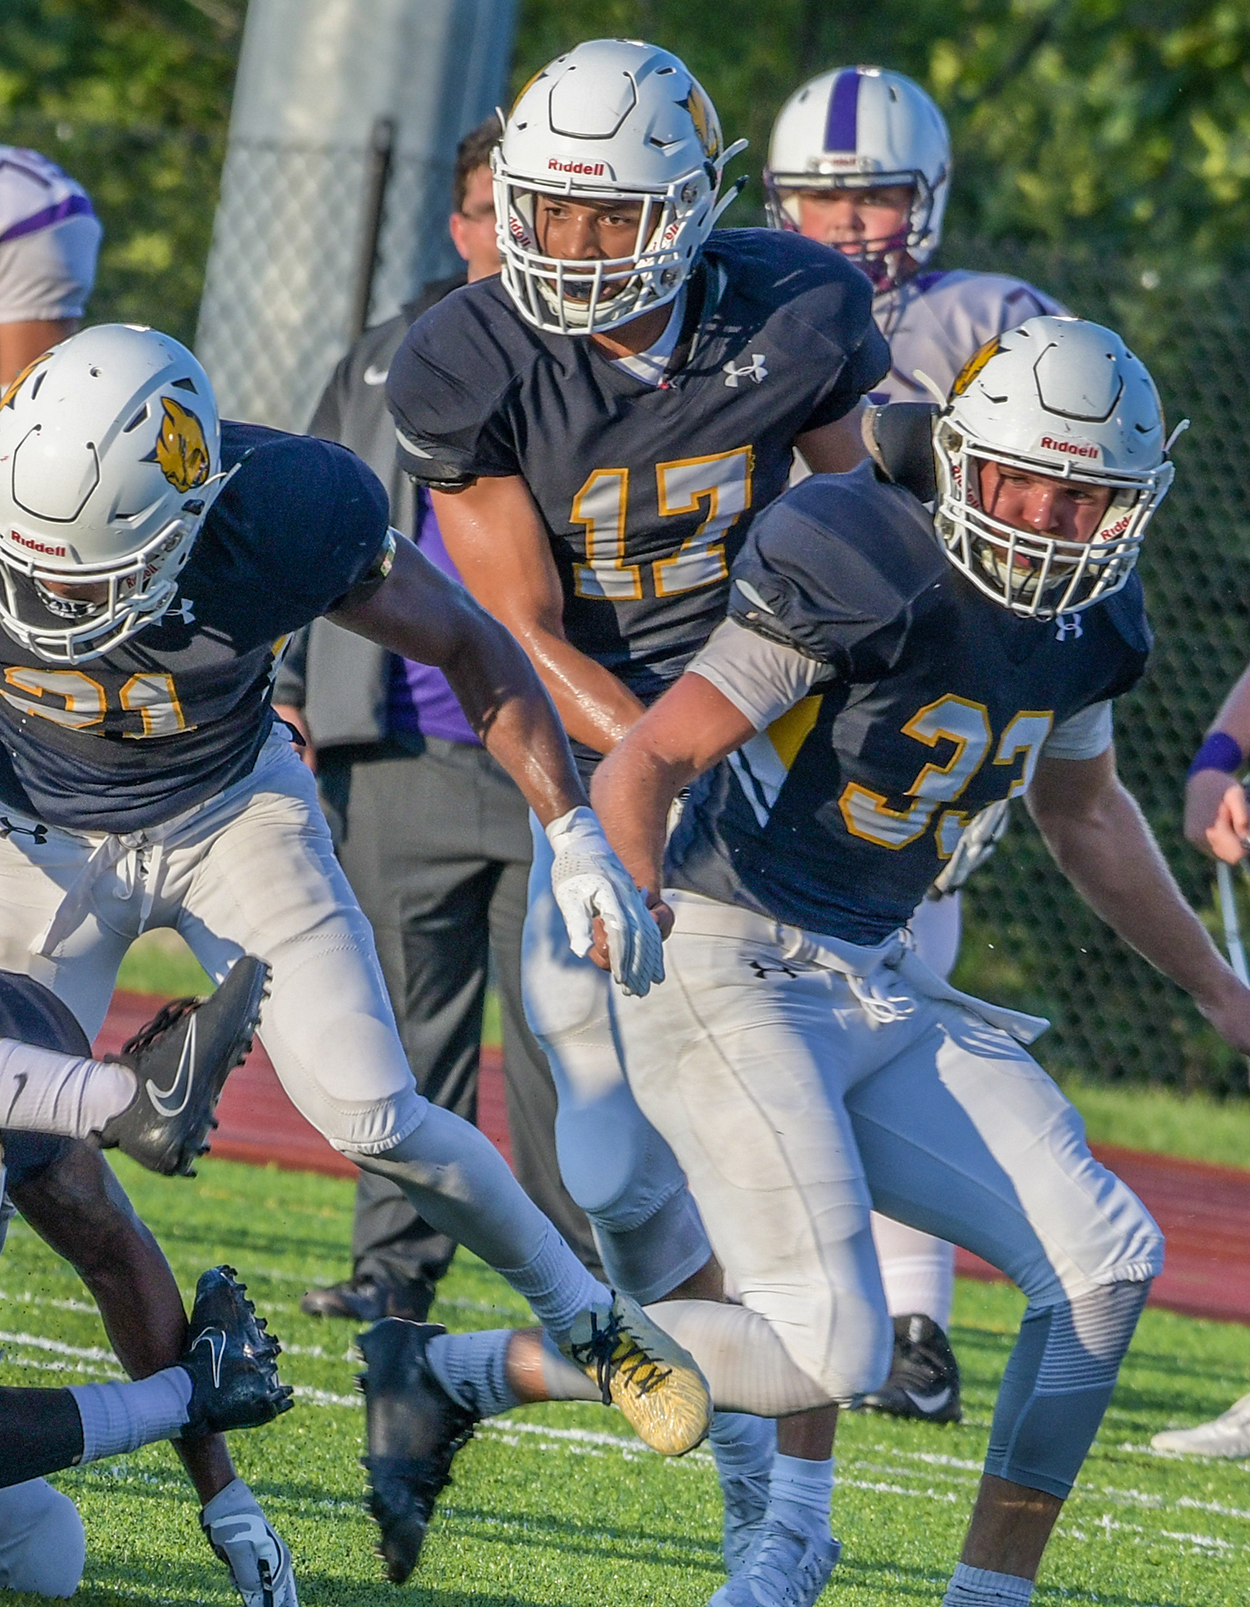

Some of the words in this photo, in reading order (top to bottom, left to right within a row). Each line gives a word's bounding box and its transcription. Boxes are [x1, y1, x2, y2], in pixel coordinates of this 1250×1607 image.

[548, 158, 605, 177] Riddell
[1040, 436, 1099, 459] Riddell
[11, 530, 66, 557] Riddell
[569, 444, 755, 600] 17
[0, 665, 198, 740] 21
[838, 692, 1054, 860] 33
